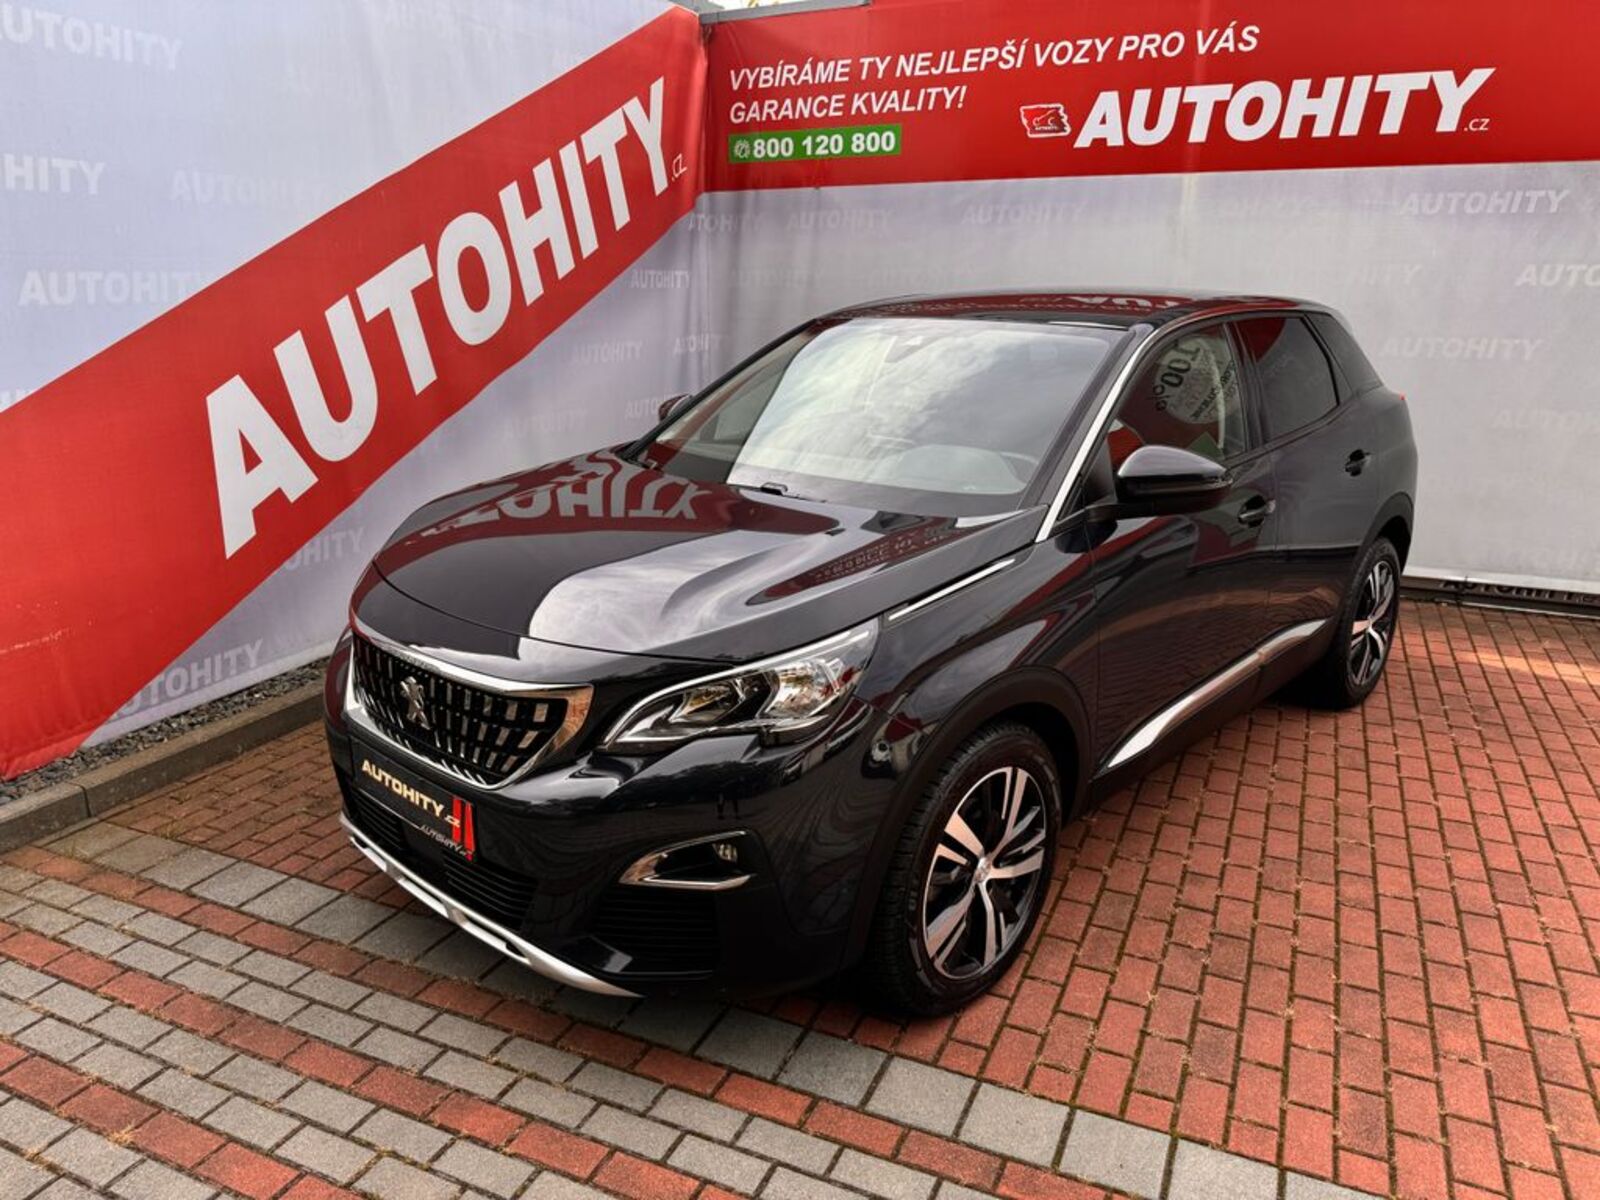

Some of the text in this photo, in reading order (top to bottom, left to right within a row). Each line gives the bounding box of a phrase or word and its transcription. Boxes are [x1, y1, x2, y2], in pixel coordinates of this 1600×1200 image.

[0, 3, 182, 71] UTOHITY
[730, 20, 1260, 91] VYBÍRÁME TY NEJLEPŠÍ VOZY PRO VÁS
[730, 85, 968, 124] GARANCE KVALITY!
[1074, 68, 1496, 148] AUTOHITY
[753, 131, 896, 158] 800 120 800
[4, 154, 106, 195] HITY
[1400, 188, 1569, 215] AUTOHITY
[18, 269, 208, 308] AUTOHIT
[206, 76, 668, 560] AUTOHITY
[1378, 336, 1544, 362] AUTOHITY
[362, 759, 444, 817] AUTOHITY
